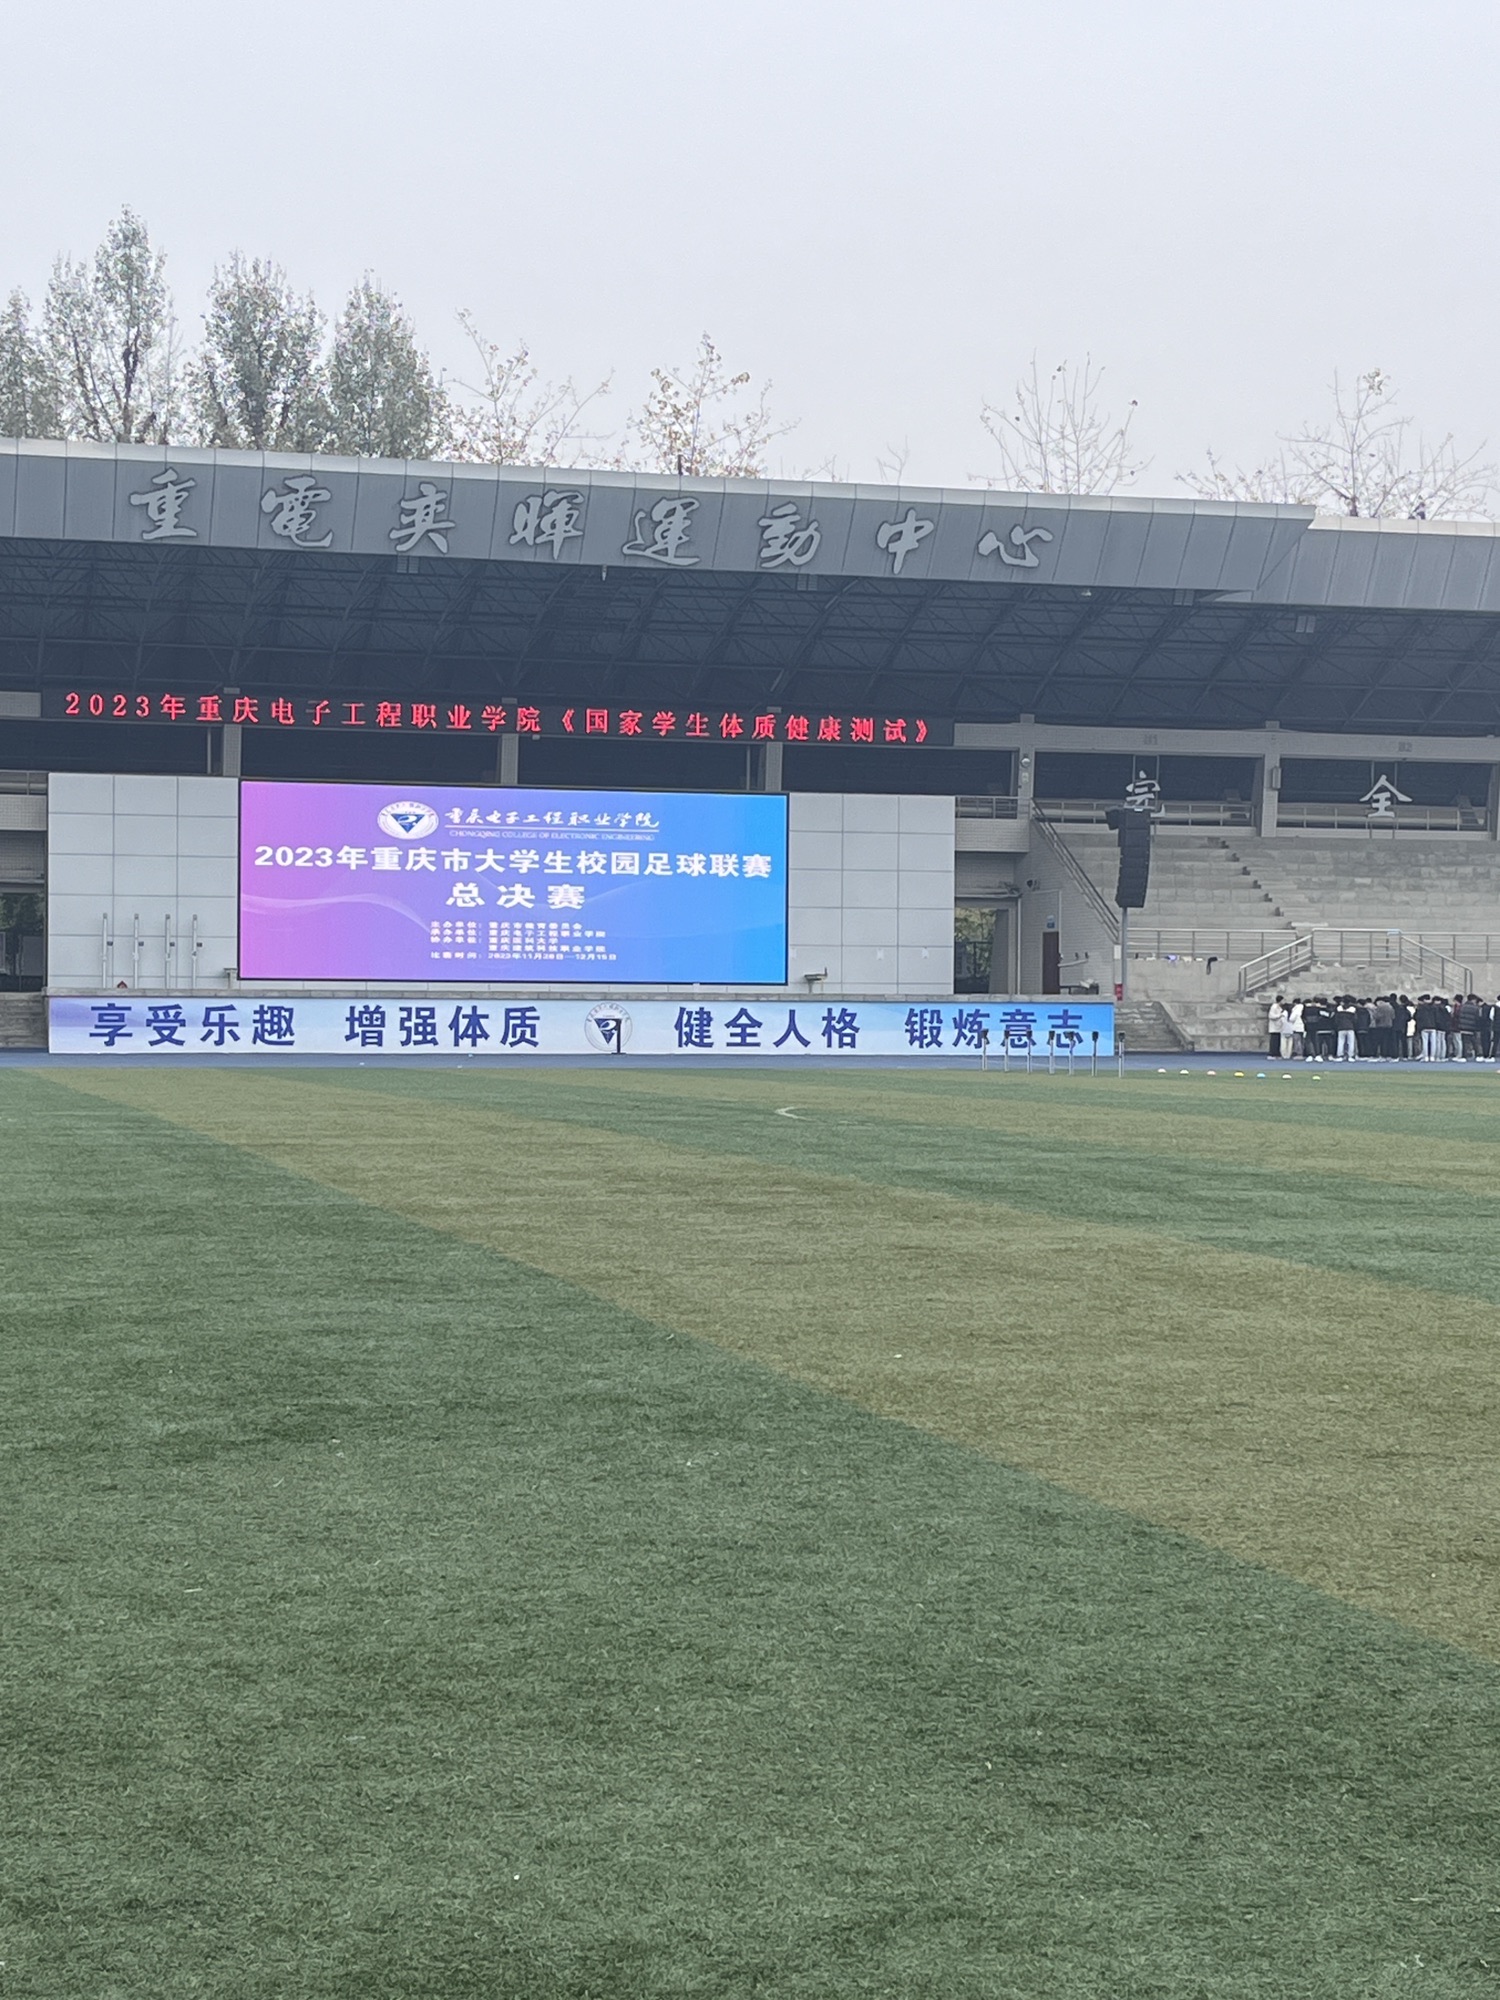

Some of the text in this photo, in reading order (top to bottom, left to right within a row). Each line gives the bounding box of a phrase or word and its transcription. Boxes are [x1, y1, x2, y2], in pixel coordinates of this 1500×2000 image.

[1359, 774, 1413, 818] 全
[253, 845, 773, 879] 2023年重庆市大学生校园足球联赛
[445, 882, 587, 910] 总决赛
[89, 1003, 296, 1048] 享受乐趣
[344, 1004, 541, 1048] 增强体质
[674, 1006, 861, 1050] 健全人格
[905, 1008, 1084, 1050] 锻炼意志
